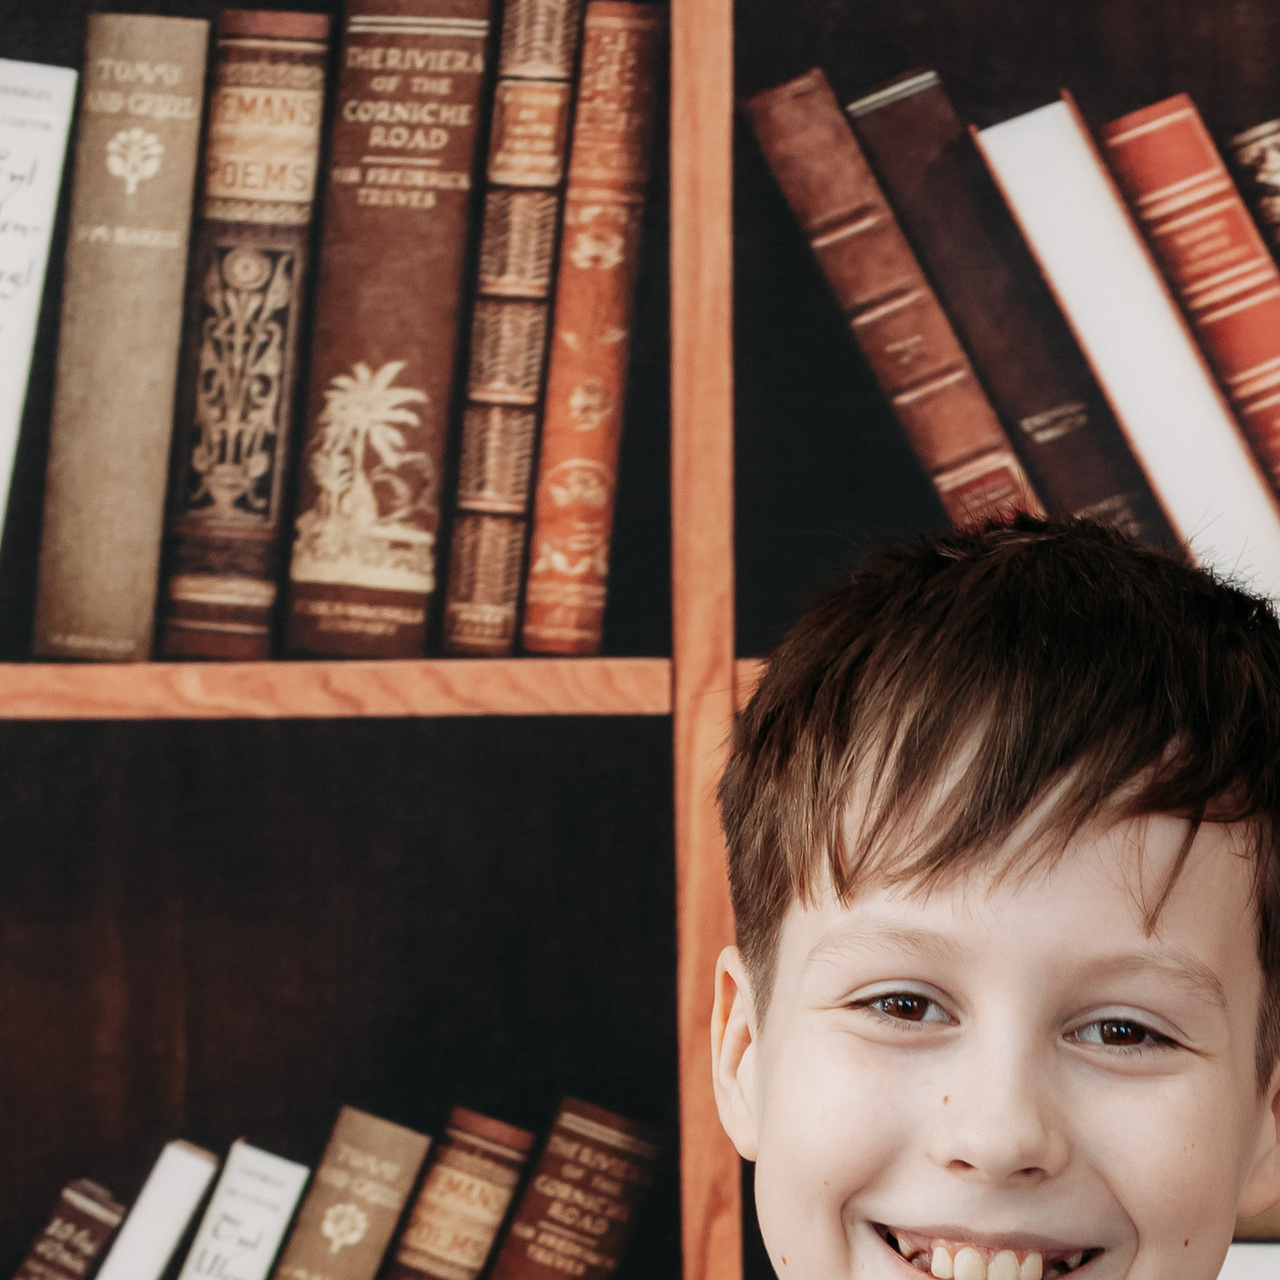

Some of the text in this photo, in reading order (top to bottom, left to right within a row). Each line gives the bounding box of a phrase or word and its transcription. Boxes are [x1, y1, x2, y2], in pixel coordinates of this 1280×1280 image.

[370, 75, 452, 96] OF THE
[342, 100, 473, 127] CORNICHE
[368, 125, 450, 151] ROAD
[546, 1199, 610, 1237] ROAD
